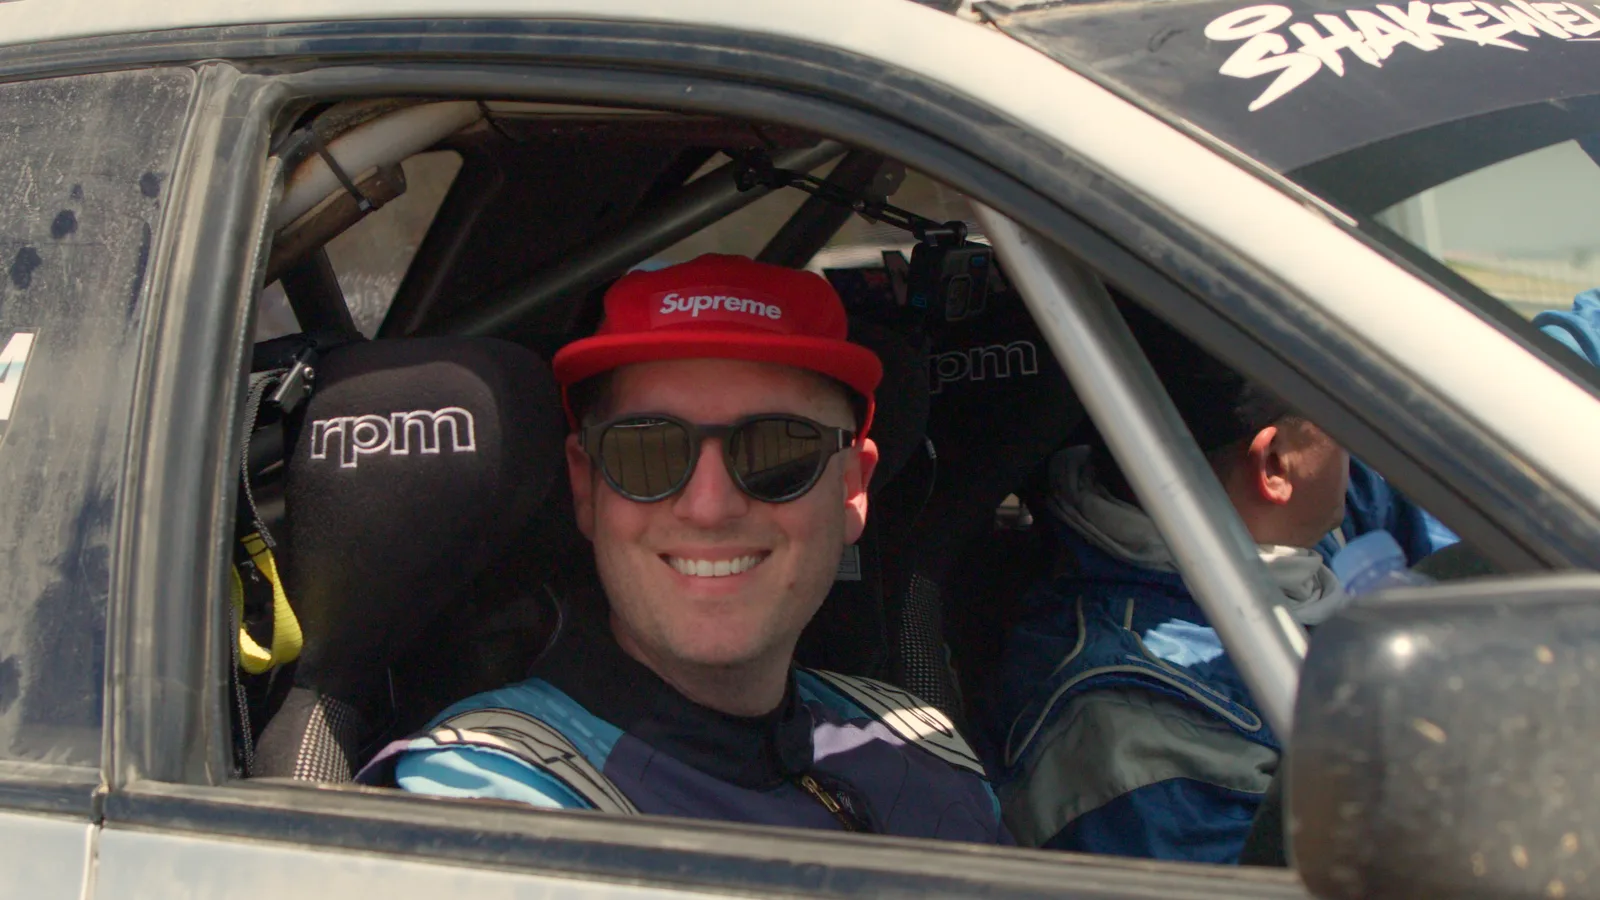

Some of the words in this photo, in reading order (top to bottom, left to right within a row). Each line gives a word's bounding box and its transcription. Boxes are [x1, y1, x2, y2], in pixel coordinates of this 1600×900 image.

[1205, 0, 1600, 112] SHAKEWEL
[660, 293, 782, 320] Supreme
[926, 340, 1039, 394] pm
[310, 406, 476, 468] rpm
